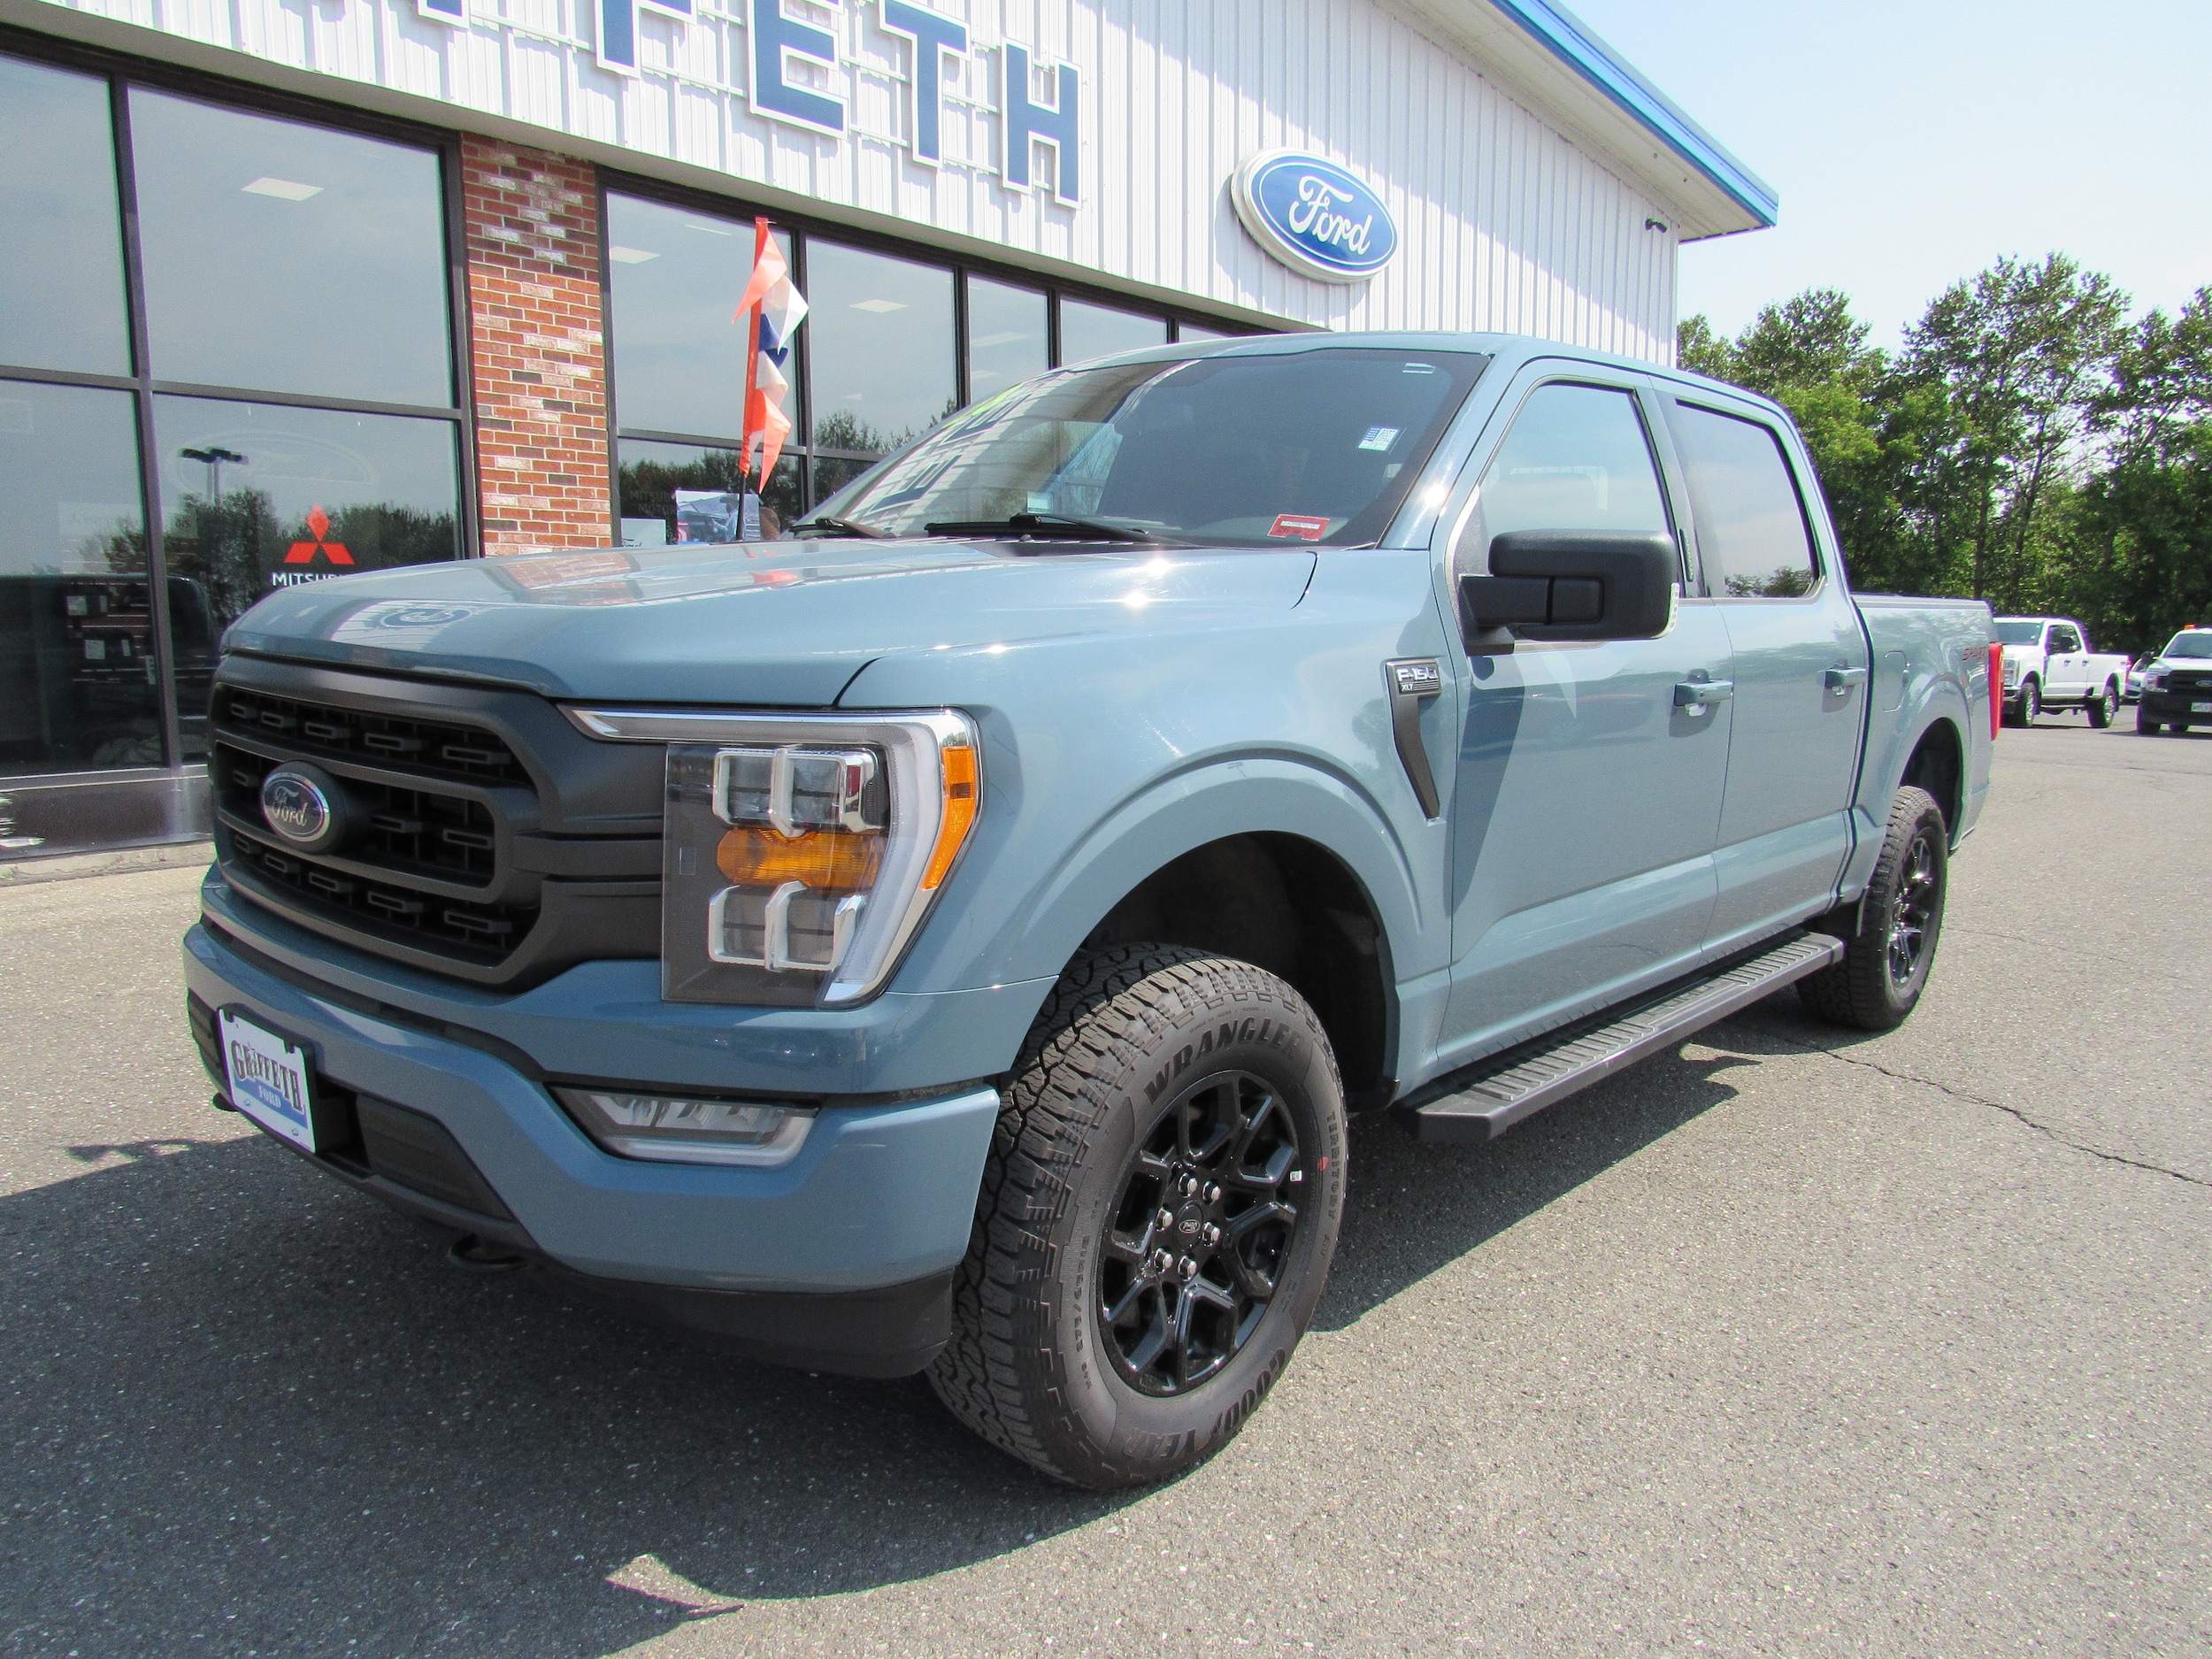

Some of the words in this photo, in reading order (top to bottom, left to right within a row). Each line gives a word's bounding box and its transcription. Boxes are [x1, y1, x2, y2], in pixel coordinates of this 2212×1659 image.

[1288, 175, 1372, 256] Ford
[271, 785, 309, 827] Ford
[1144, 1015, 1303, 1105] WRANGLER
